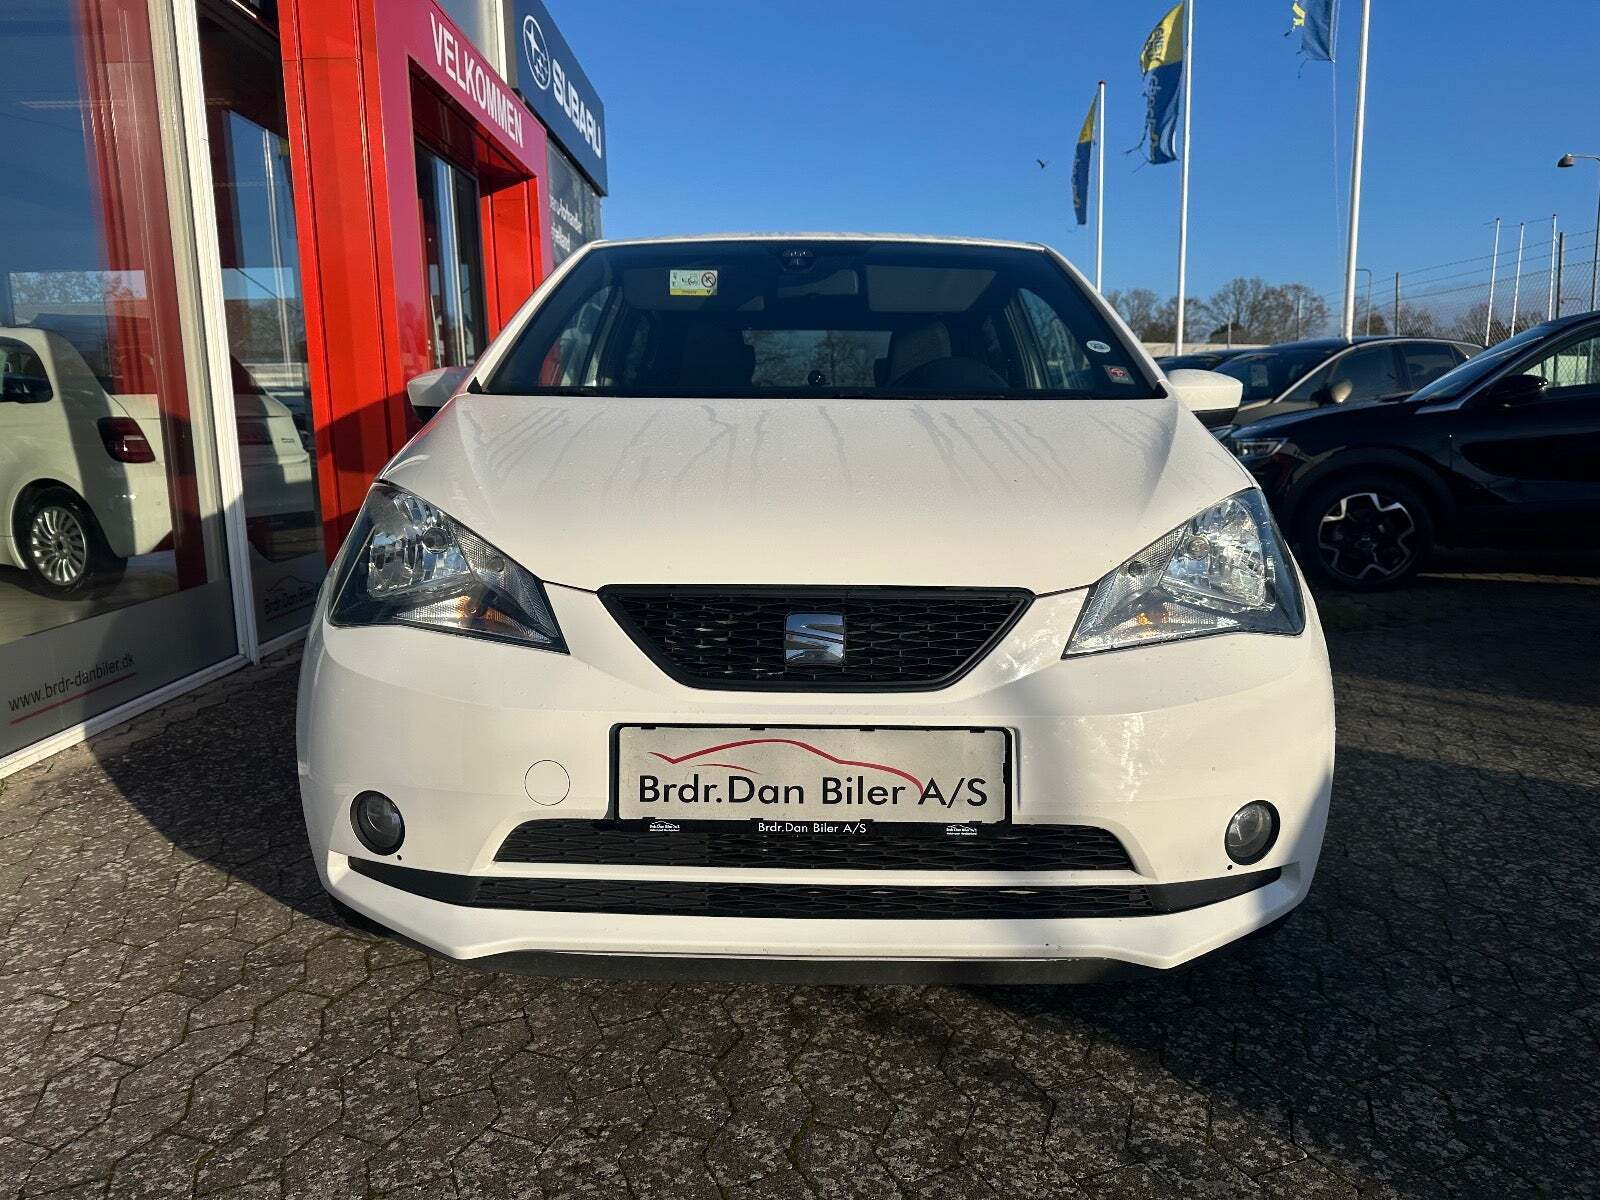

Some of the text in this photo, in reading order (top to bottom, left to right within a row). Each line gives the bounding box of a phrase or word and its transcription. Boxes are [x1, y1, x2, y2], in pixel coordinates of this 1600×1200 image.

[430, 12, 524, 148] VELKOMMEN
[552, 58, 602, 159] SUBARU
[8, 652, 136, 712] www.brdr-danbiler.dk
[639, 773, 988, 808] Brdr.Dan Biler A/S
[758, 822, 867, 834] Brdr.Dan Biler A/S
